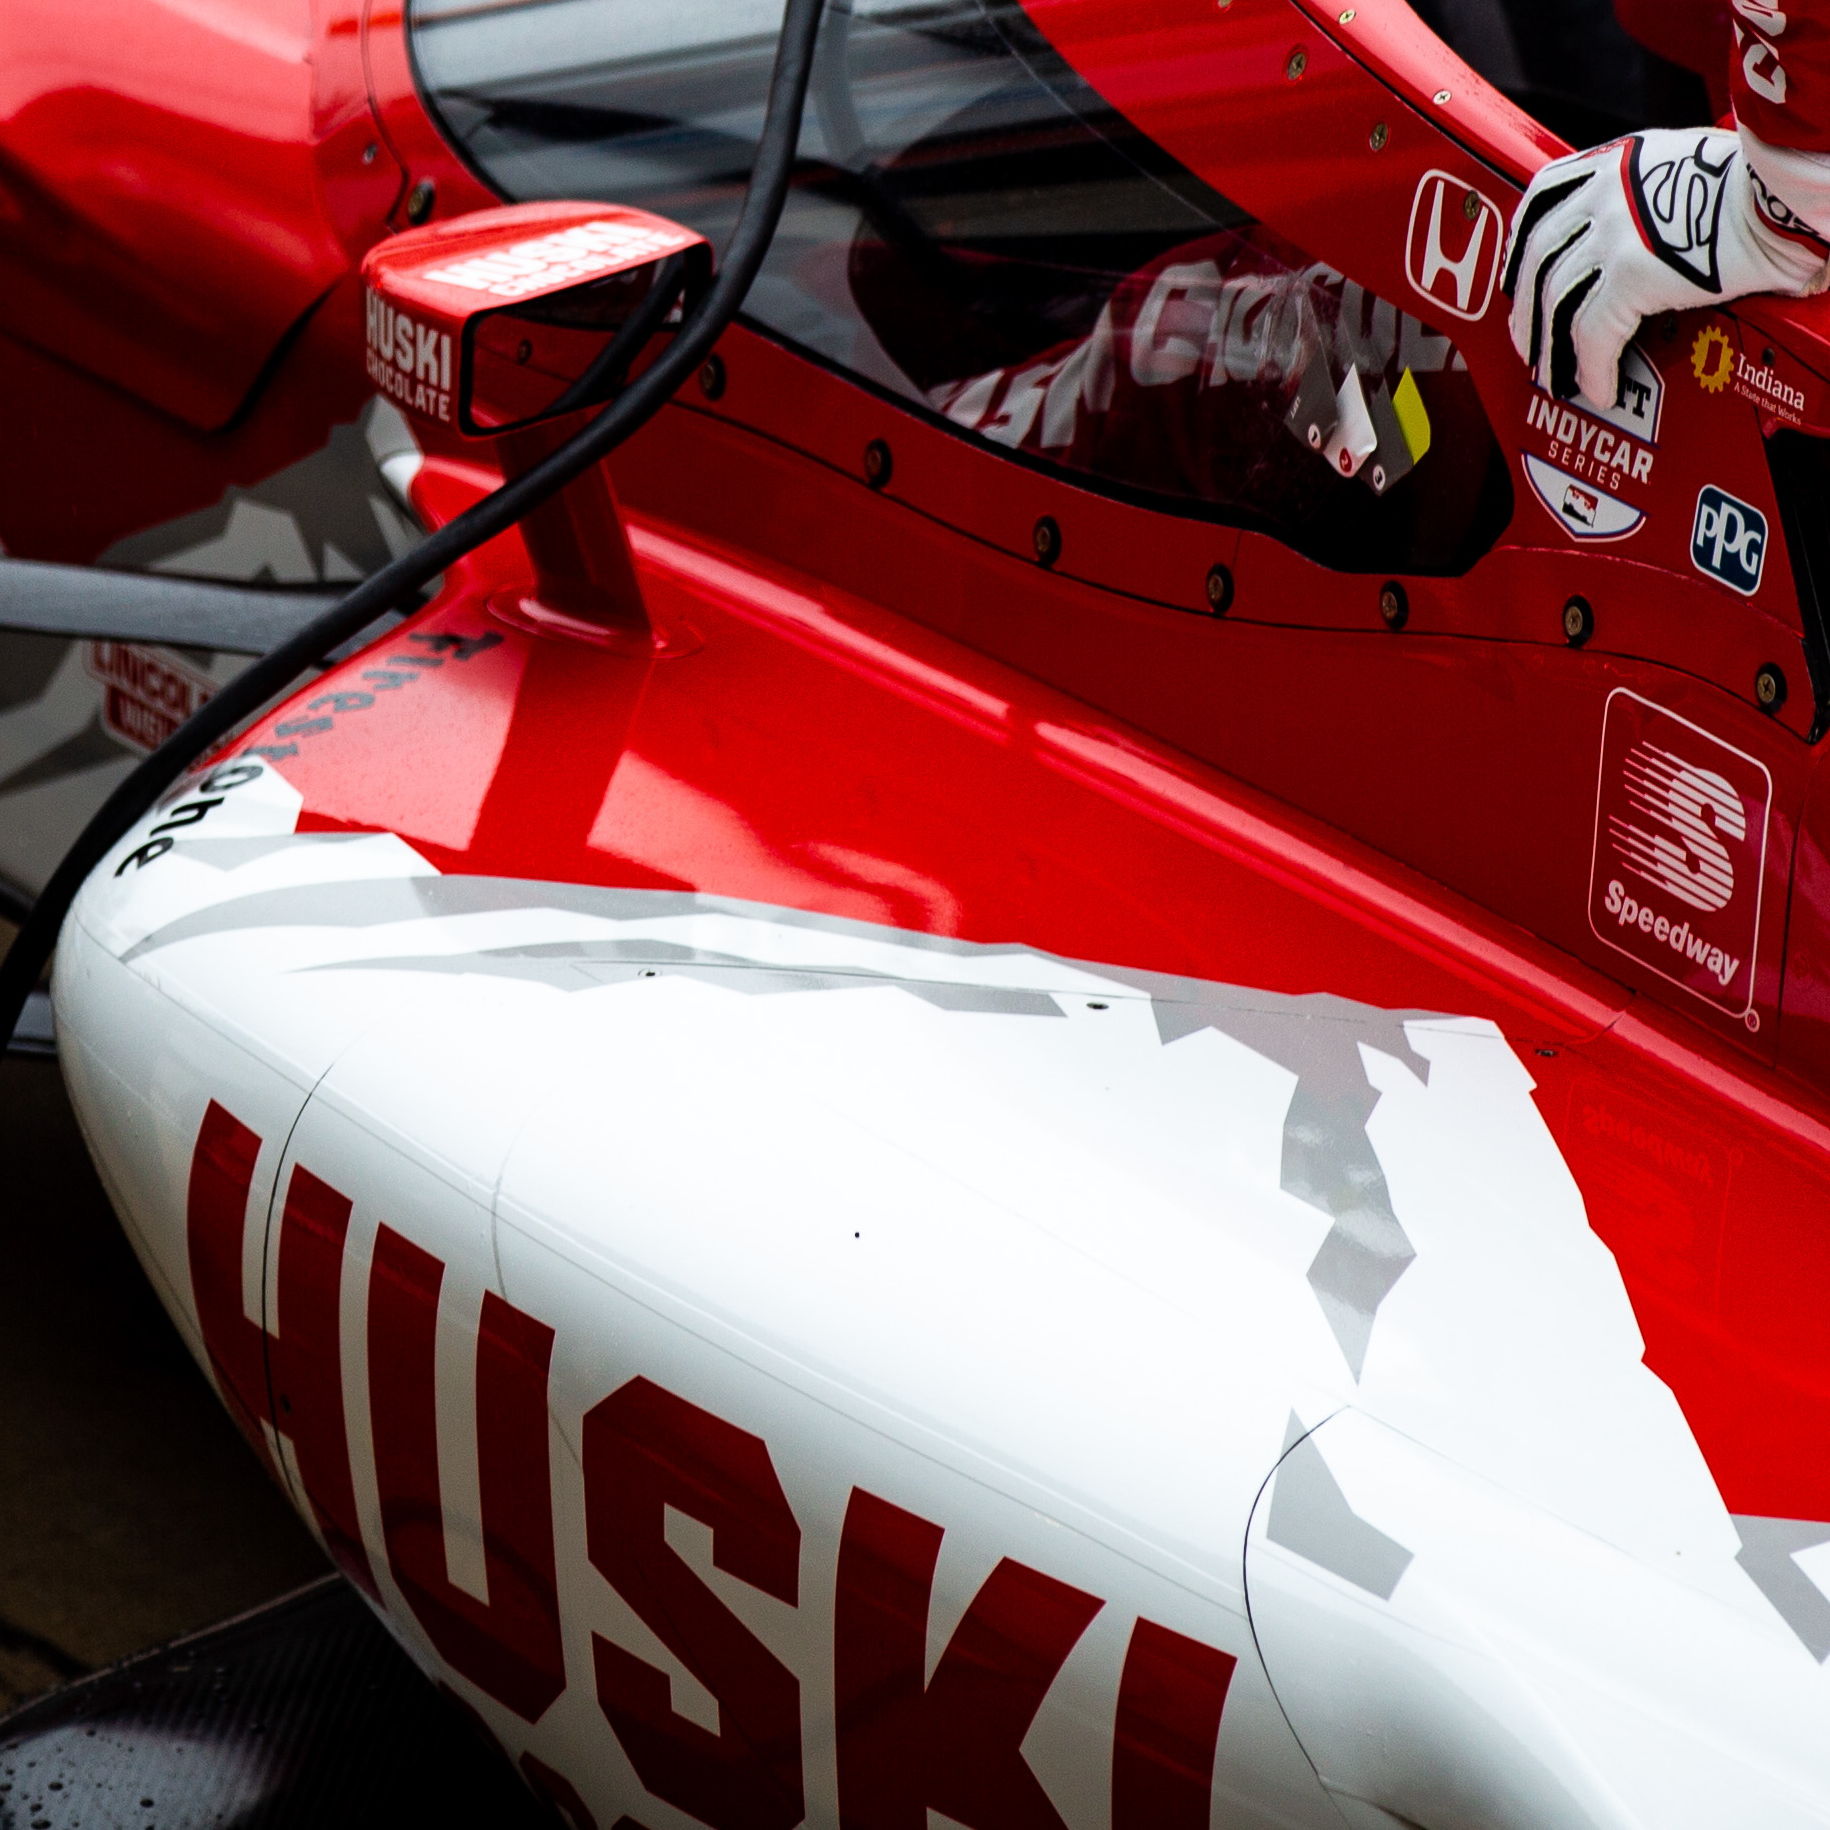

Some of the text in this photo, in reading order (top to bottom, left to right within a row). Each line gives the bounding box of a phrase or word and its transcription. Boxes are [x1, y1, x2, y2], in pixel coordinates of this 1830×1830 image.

[423, 221, 653, 290] HUSKI
[366, 286, 451, 392] HUSKI
[366, 347, 451, 422] CHOCOLATE
[1736, 352, 1805, 411] Indiana
[1526, 394, 1654, 484] INDYCAR
[1547, 439, 1621, 491] SERIES
[1696, 500, 1762, 576] PPG
[1604, 878, 1739, 987] Speedway
